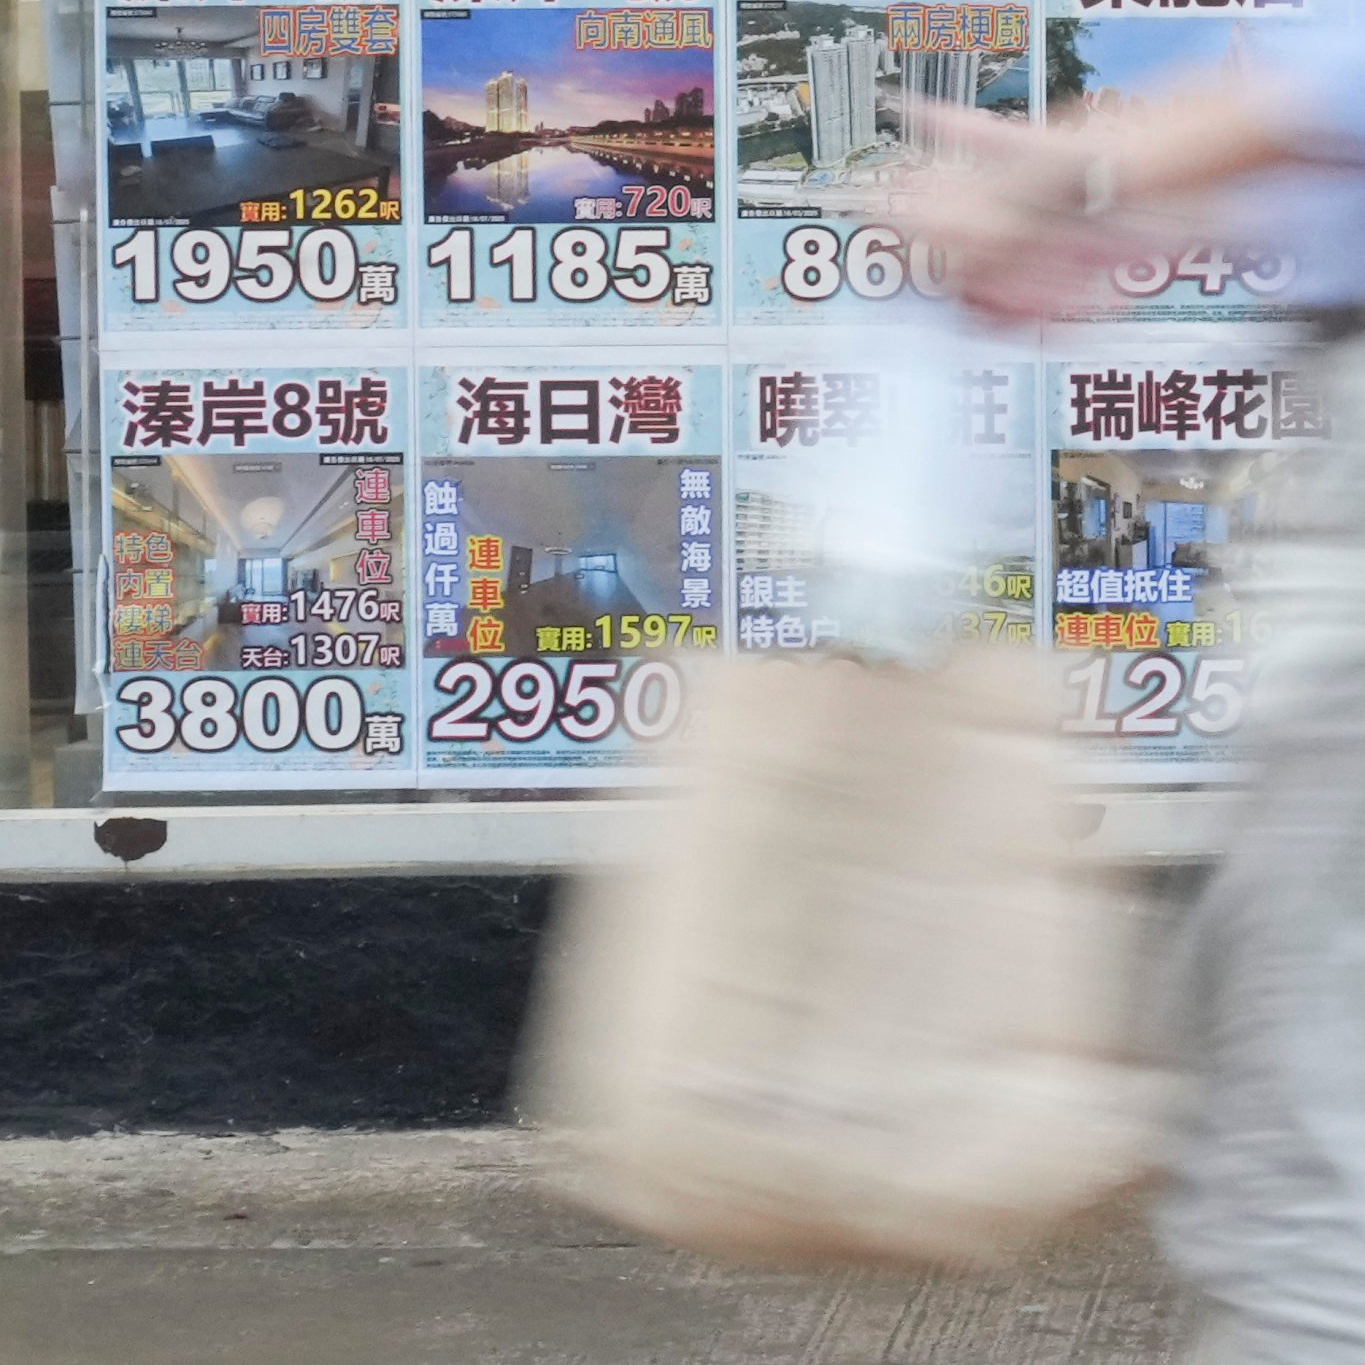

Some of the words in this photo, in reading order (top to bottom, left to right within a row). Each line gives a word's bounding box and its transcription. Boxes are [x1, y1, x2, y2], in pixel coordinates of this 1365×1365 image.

[258, 7, 400, 56] 四房雙套
[574, 9, 713, 51] 向南通風
[888, 5, 1029, 52] 兩房梗廚
[239, 188, 401, 223] 實用:1262呎
[573, 185, 712, 221] 實用:720呎
[112, 227, 397, 304] 1950萬
[429, 227, 712, 304] 1185萬
[120, 378, 389, 448] 溱岸8號
[455, 377, 684, 446] 海日灣
[1070, 369, 1332, 441] 瑞峰花園
[114, 531, 174, 564] 特色
[354, 469, 393, 584] 連車位
[679, 469, 713, 610] 無敵海景
[423, 479, 461, 637] 蝕過仟萬
[241, 590, 400, 623] 實用:1476呎
[468, 535, 503, 653] 連車位
[740, 575, 808, 609] 銀主
[1056, 569, 1194, 604] 超值抵住
[114, 603, 174, 635] 樓梯
[536, 615, 717, 651] 實用:1597呎
[1056, 613, 1161, 649] 連車位
[114, 638, 205, 671] 連天台
[241, 635, 400, 668] 天台:1307呎
[117, 677, 402, 754] 3800萬
[431, 661, 683, 742] 2950
